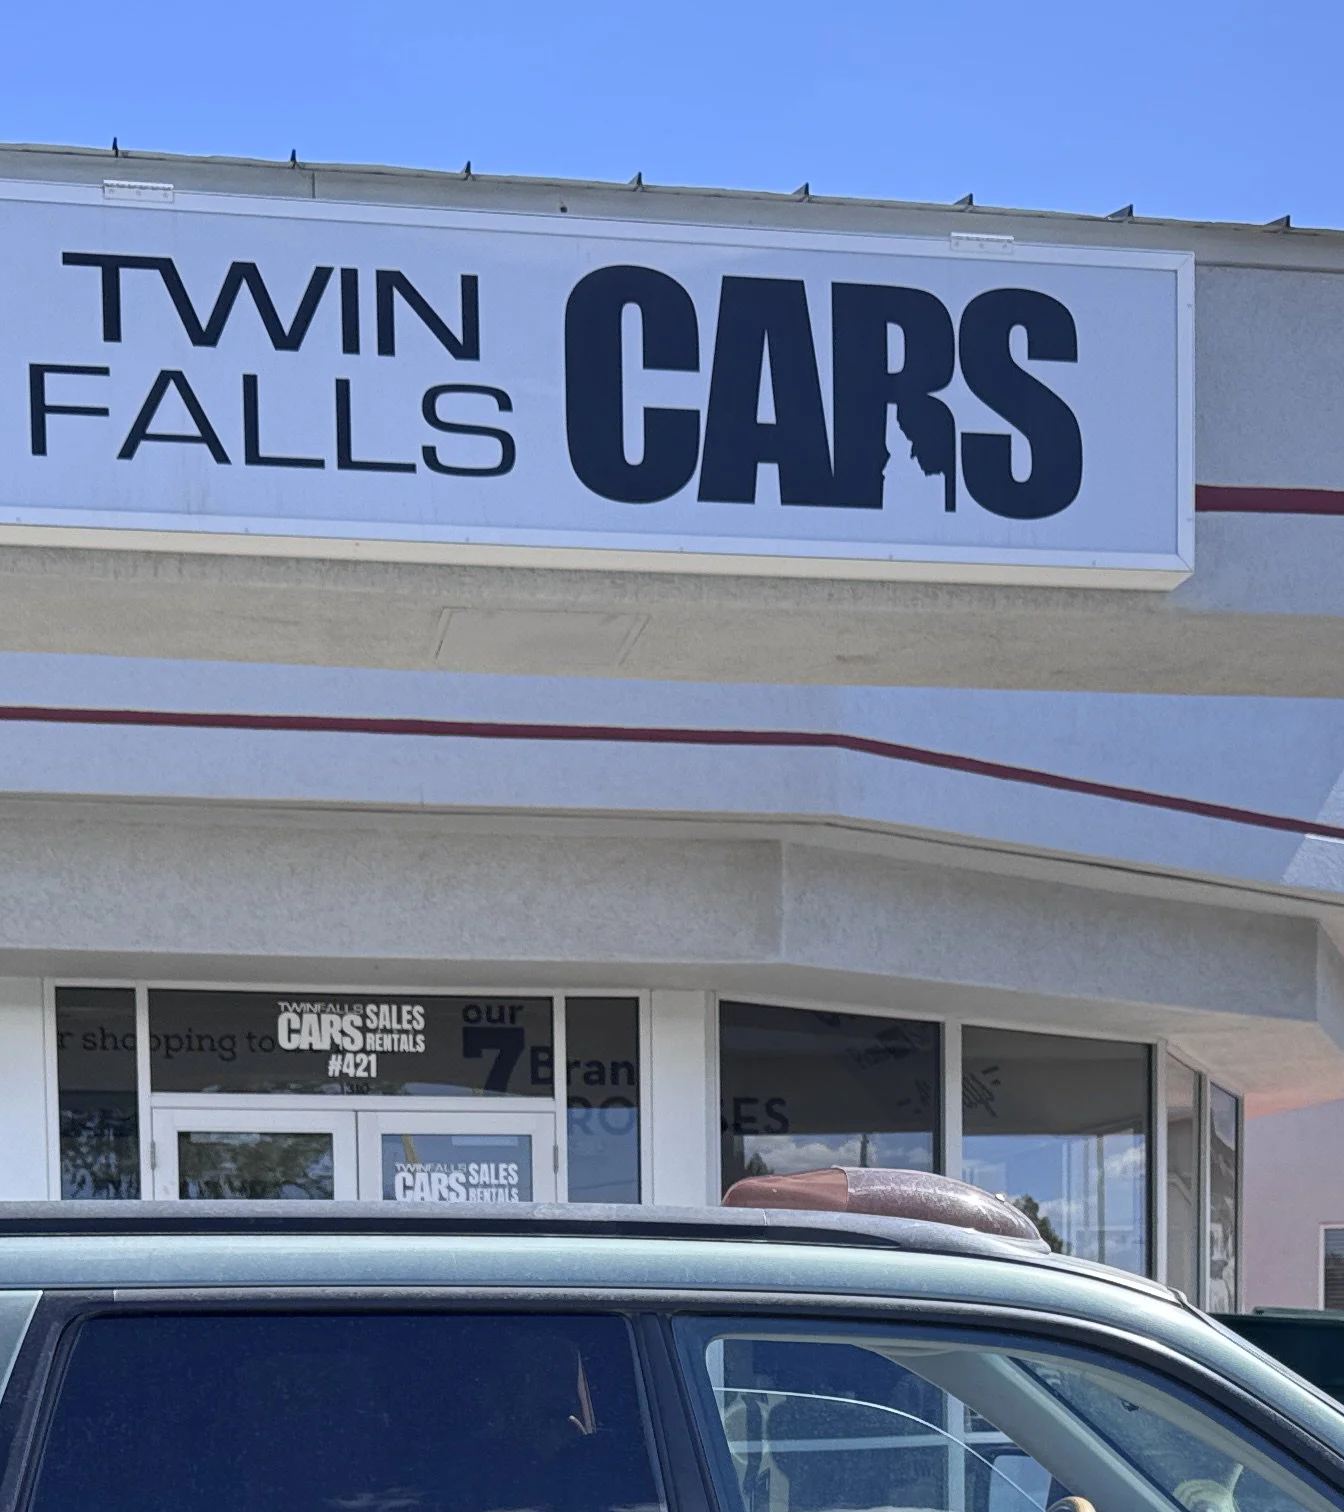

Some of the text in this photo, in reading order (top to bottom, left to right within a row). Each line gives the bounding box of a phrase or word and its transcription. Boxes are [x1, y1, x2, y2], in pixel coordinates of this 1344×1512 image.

[61, 251, 480, 362] TWIN
[564, 264, 1084, 521] CARS
[28, 363, 516, 478] FALLS
[365, 1004, 425, 1030] SALES
[462, 1002, 523, 1025] our
[277, 1012, 364, 1052] CARS
[366, 1032, 426, 1053] RENTALS
[328, 1053, 378, 1078] #421
[462, 1026, 636, 1092] 7 Bran
[395, 1172, 467, 1202] CARS
[468, 1162, 520, 1185] SALES
[468, 1187, 520, 1203] RENTALS
